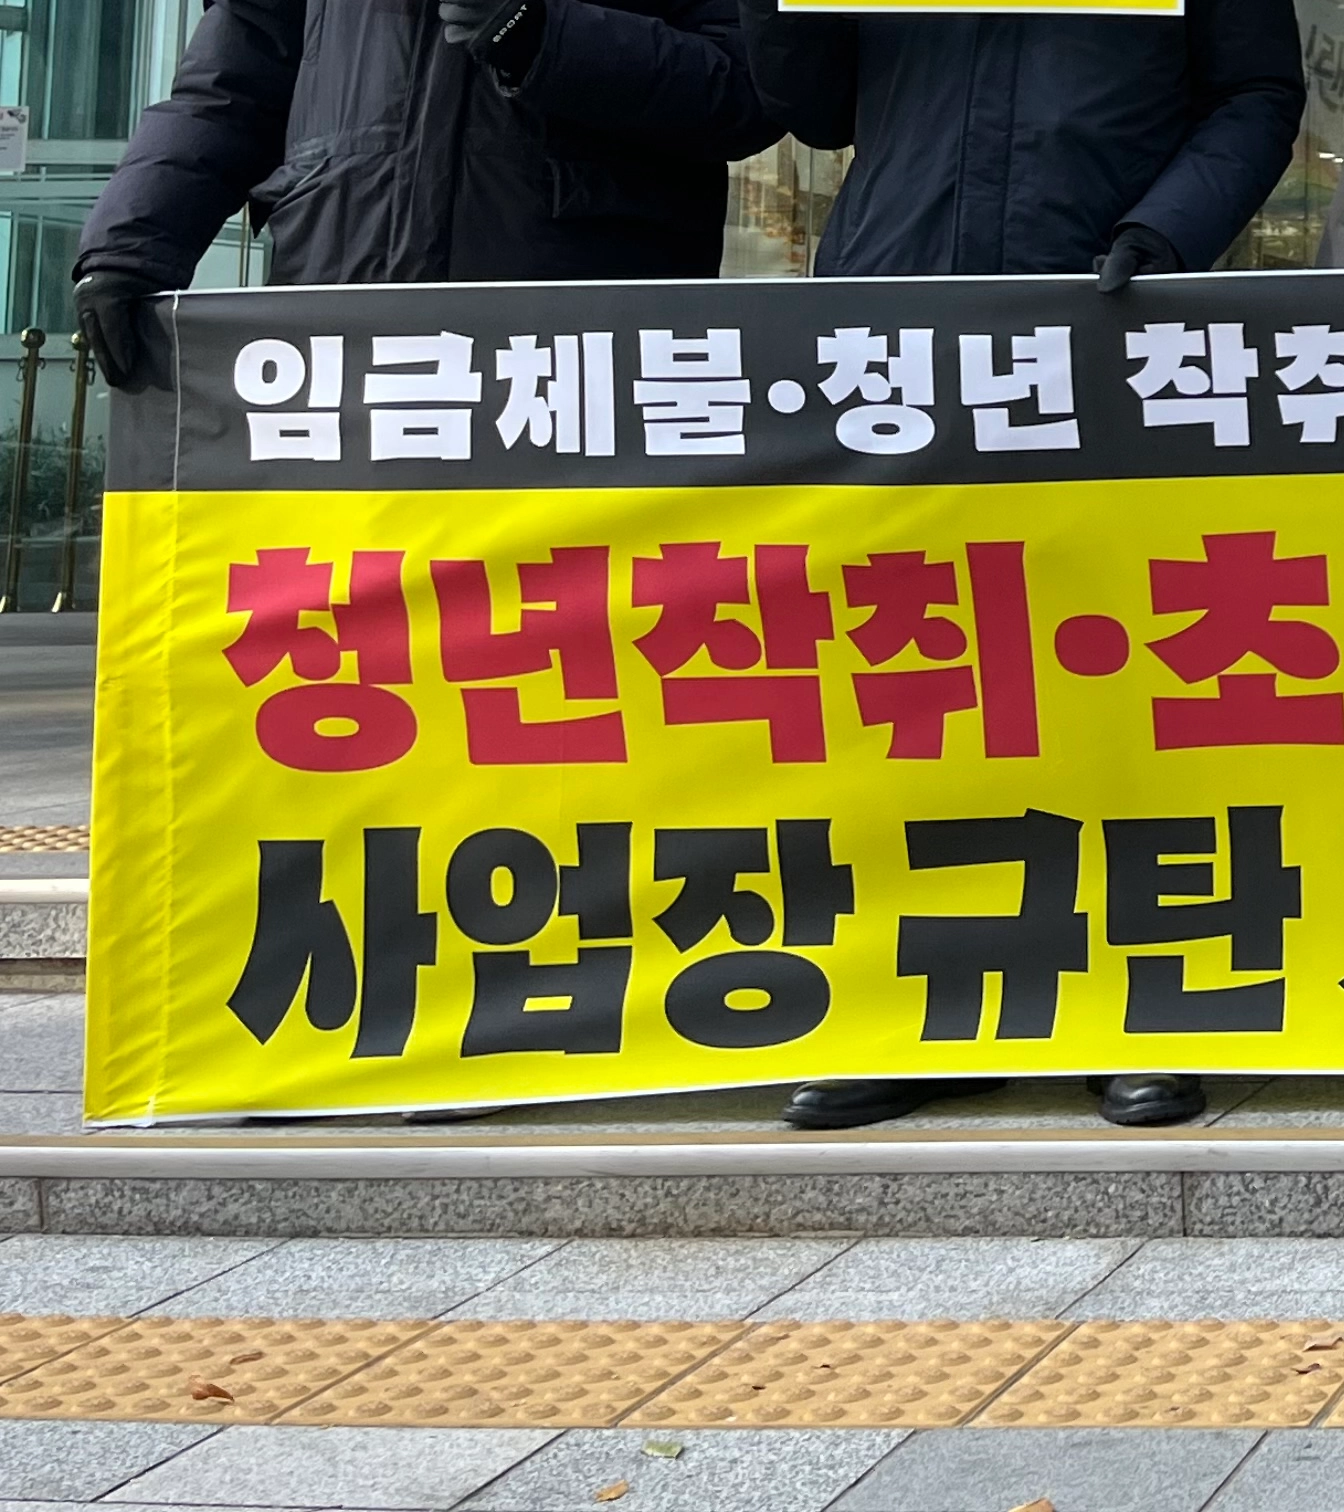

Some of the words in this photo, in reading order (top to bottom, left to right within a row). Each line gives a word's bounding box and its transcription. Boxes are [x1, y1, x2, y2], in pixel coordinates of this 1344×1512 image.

[233, 321, 1082, 463] 임금체불·청년
[225, 817, 855, 1060] 사업장
[895, 803, 1304, 1043] 규탄
